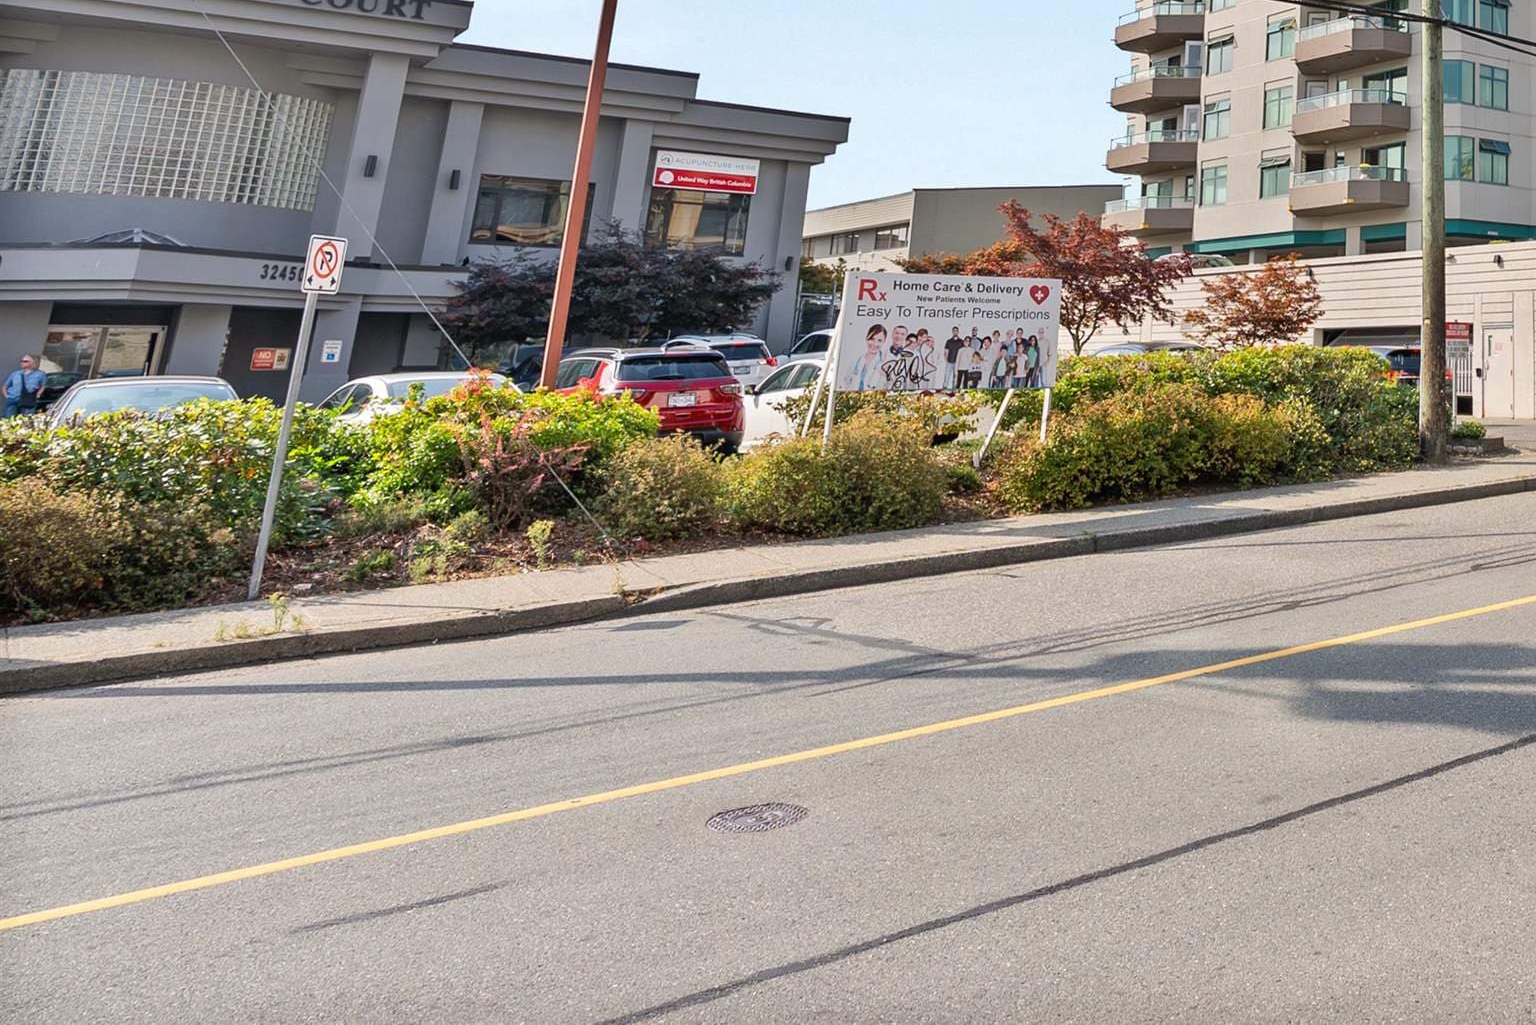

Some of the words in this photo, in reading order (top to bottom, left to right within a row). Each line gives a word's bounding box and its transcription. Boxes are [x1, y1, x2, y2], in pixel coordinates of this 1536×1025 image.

[675, 158, 732, 169] ACUPUNCTURE
[677, 175, 696, 183] United
[697, 176, 709, 186] Way
[709, 178, 727, 186] British
[727, 179, 752, 188] Columbia
[893, 280, 929, 292] Home
[933, 281, 961, 293] Care
[964, 283, 972, 293] &
[977, 283, 1024, 297] Delivery
[916, 294, 933, 302] New
[935, 295, 966, 304] Patients
[967, 296, 1001, 305] Welcome
[856, 305, 892, 319] Easy
[896, 305, 912, 317] To
[916, 306, 968, 318] Transfer
[972, 306, 1050, 321] Prescriptions
[258, 351, 272, 359] NO
